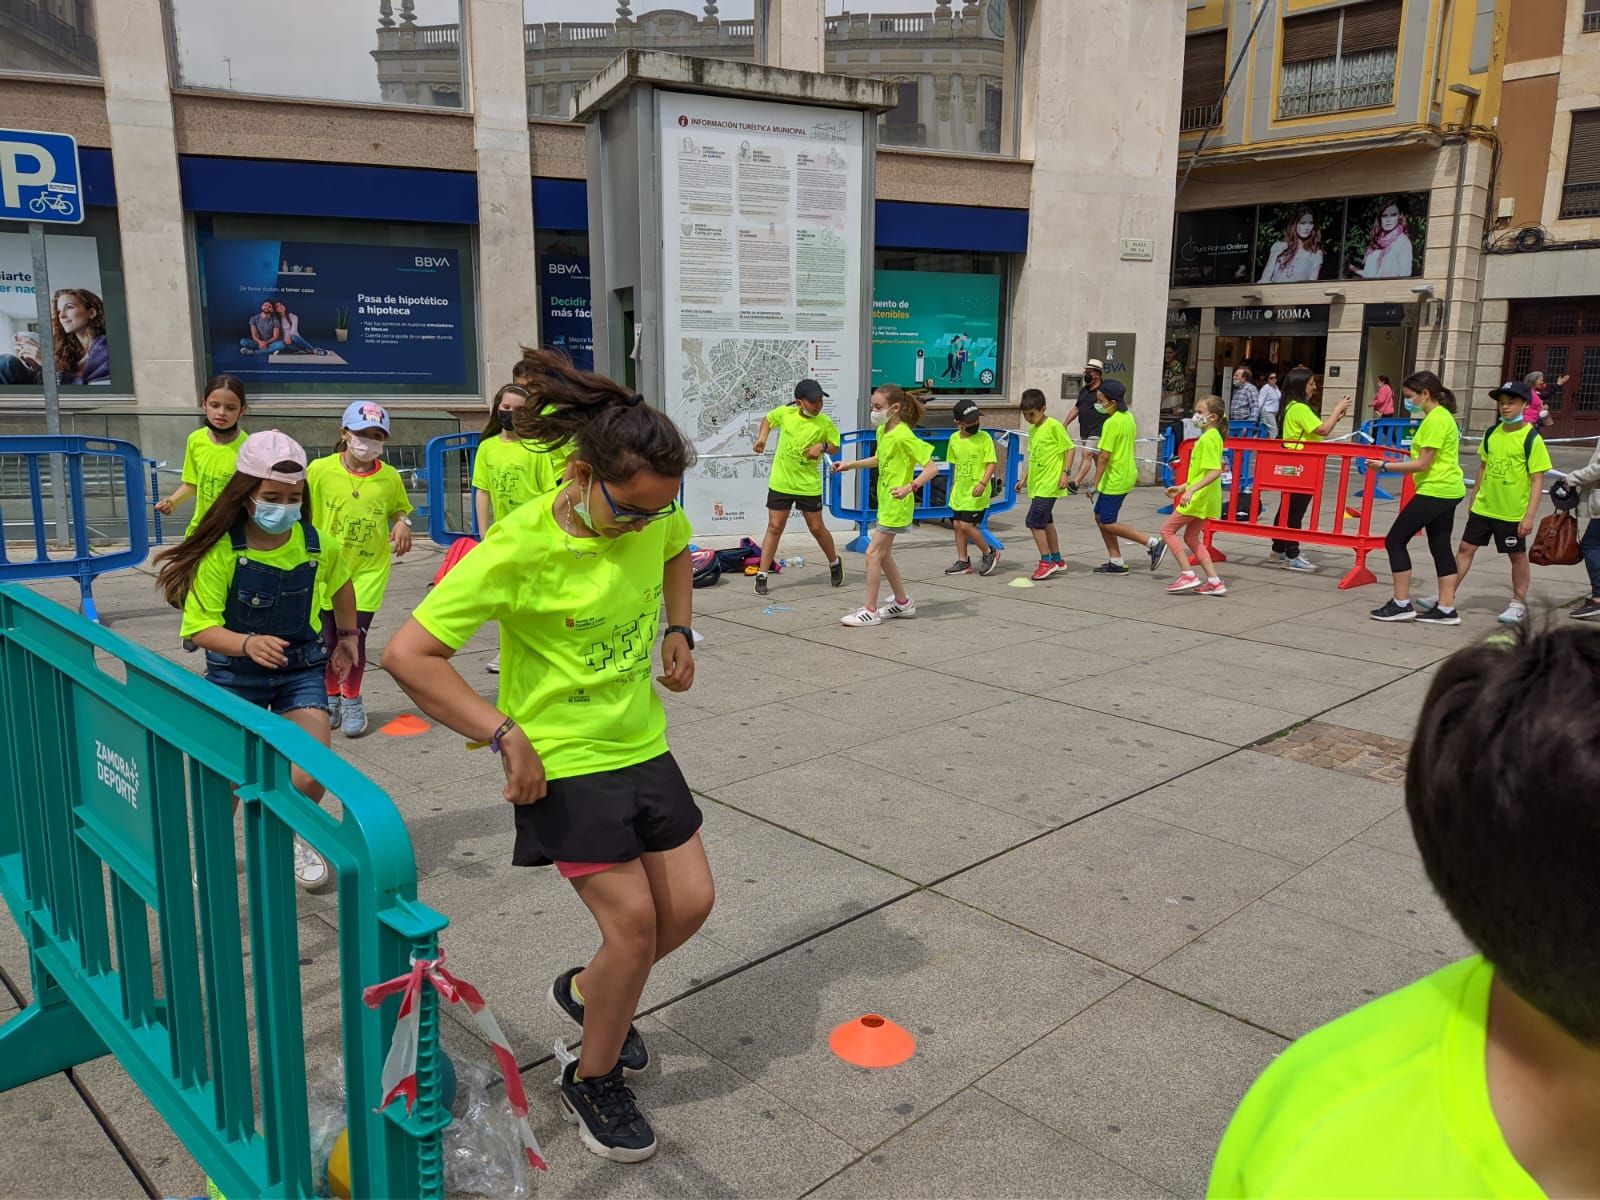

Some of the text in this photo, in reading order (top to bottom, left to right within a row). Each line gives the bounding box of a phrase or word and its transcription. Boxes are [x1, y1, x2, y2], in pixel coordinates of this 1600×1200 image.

[691, 118, 807, 136] INFORMACIÓN TURÍSTICA MUNICIPAL
[0, 140, 57, 209] P
[1226, 242, 1249, 250] Online
[415, 256, 450, 267] BBVA
[548, 263, 581, 274] BBVA
[357, 293, 449, 306] Pasa de hipotético
[550, 296, 587, 307] Decidir
[898, 300, 910, 309] de
[367, 305, 411, 316] hipoteca
[551, 308, 573, 317] más
[1232, 308, 1311, 320] PUNT ROMA
[1104, 362, 1127, 374] BVA
[95, 740, 132, 782] ZAMORA
[97, 761, 138, 810] DEPORTE
